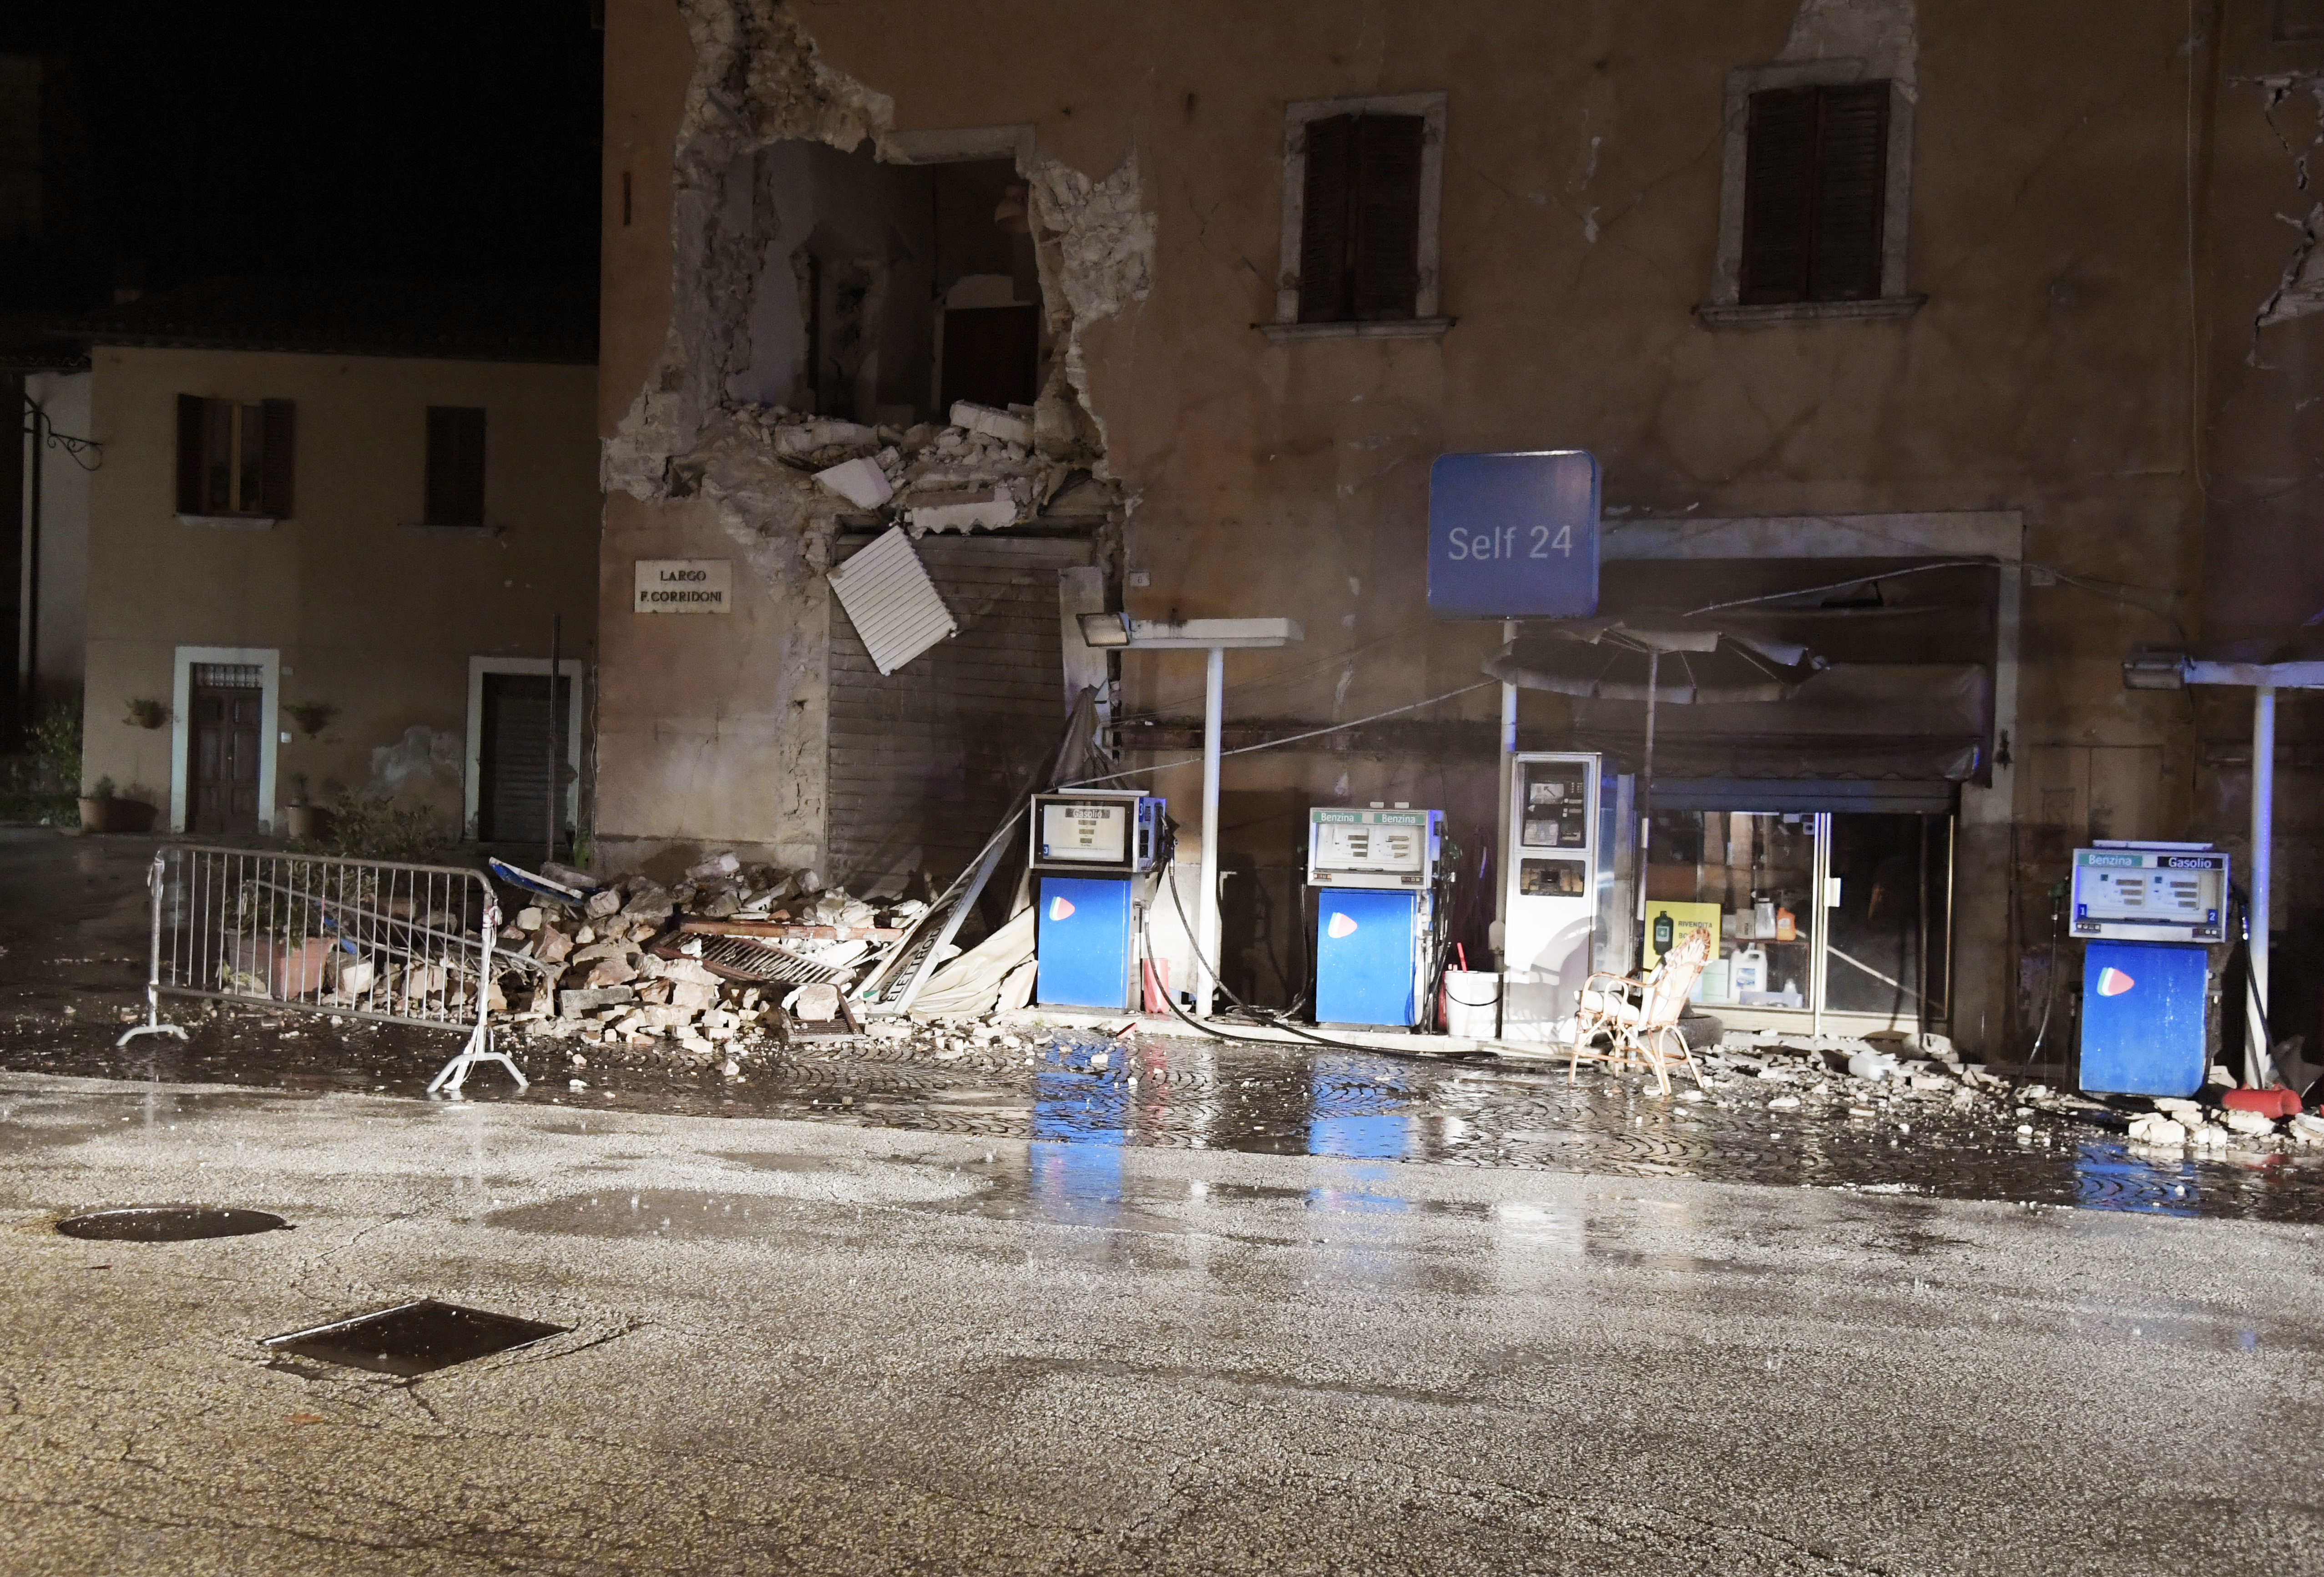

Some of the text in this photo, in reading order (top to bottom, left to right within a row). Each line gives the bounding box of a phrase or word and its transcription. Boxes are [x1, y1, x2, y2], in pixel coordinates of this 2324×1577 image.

[1448, 525, 1573, 561] Self 24
[661, 570, 706, 581] LARGO
[1072, 809, 1102, 819] Gasolio
[1139, 803, 1143, 816] 3
[1321, 813, 1354, 822] Benzina
[1381, 814, 1416, 824] Benzina
[2088, 854, 2132, 866] Benzina
[2168, 857, 2212, 868] Gasolio
[2080, 907, 2086, 915] 1
[2209, 912, 2216, 921] 2
